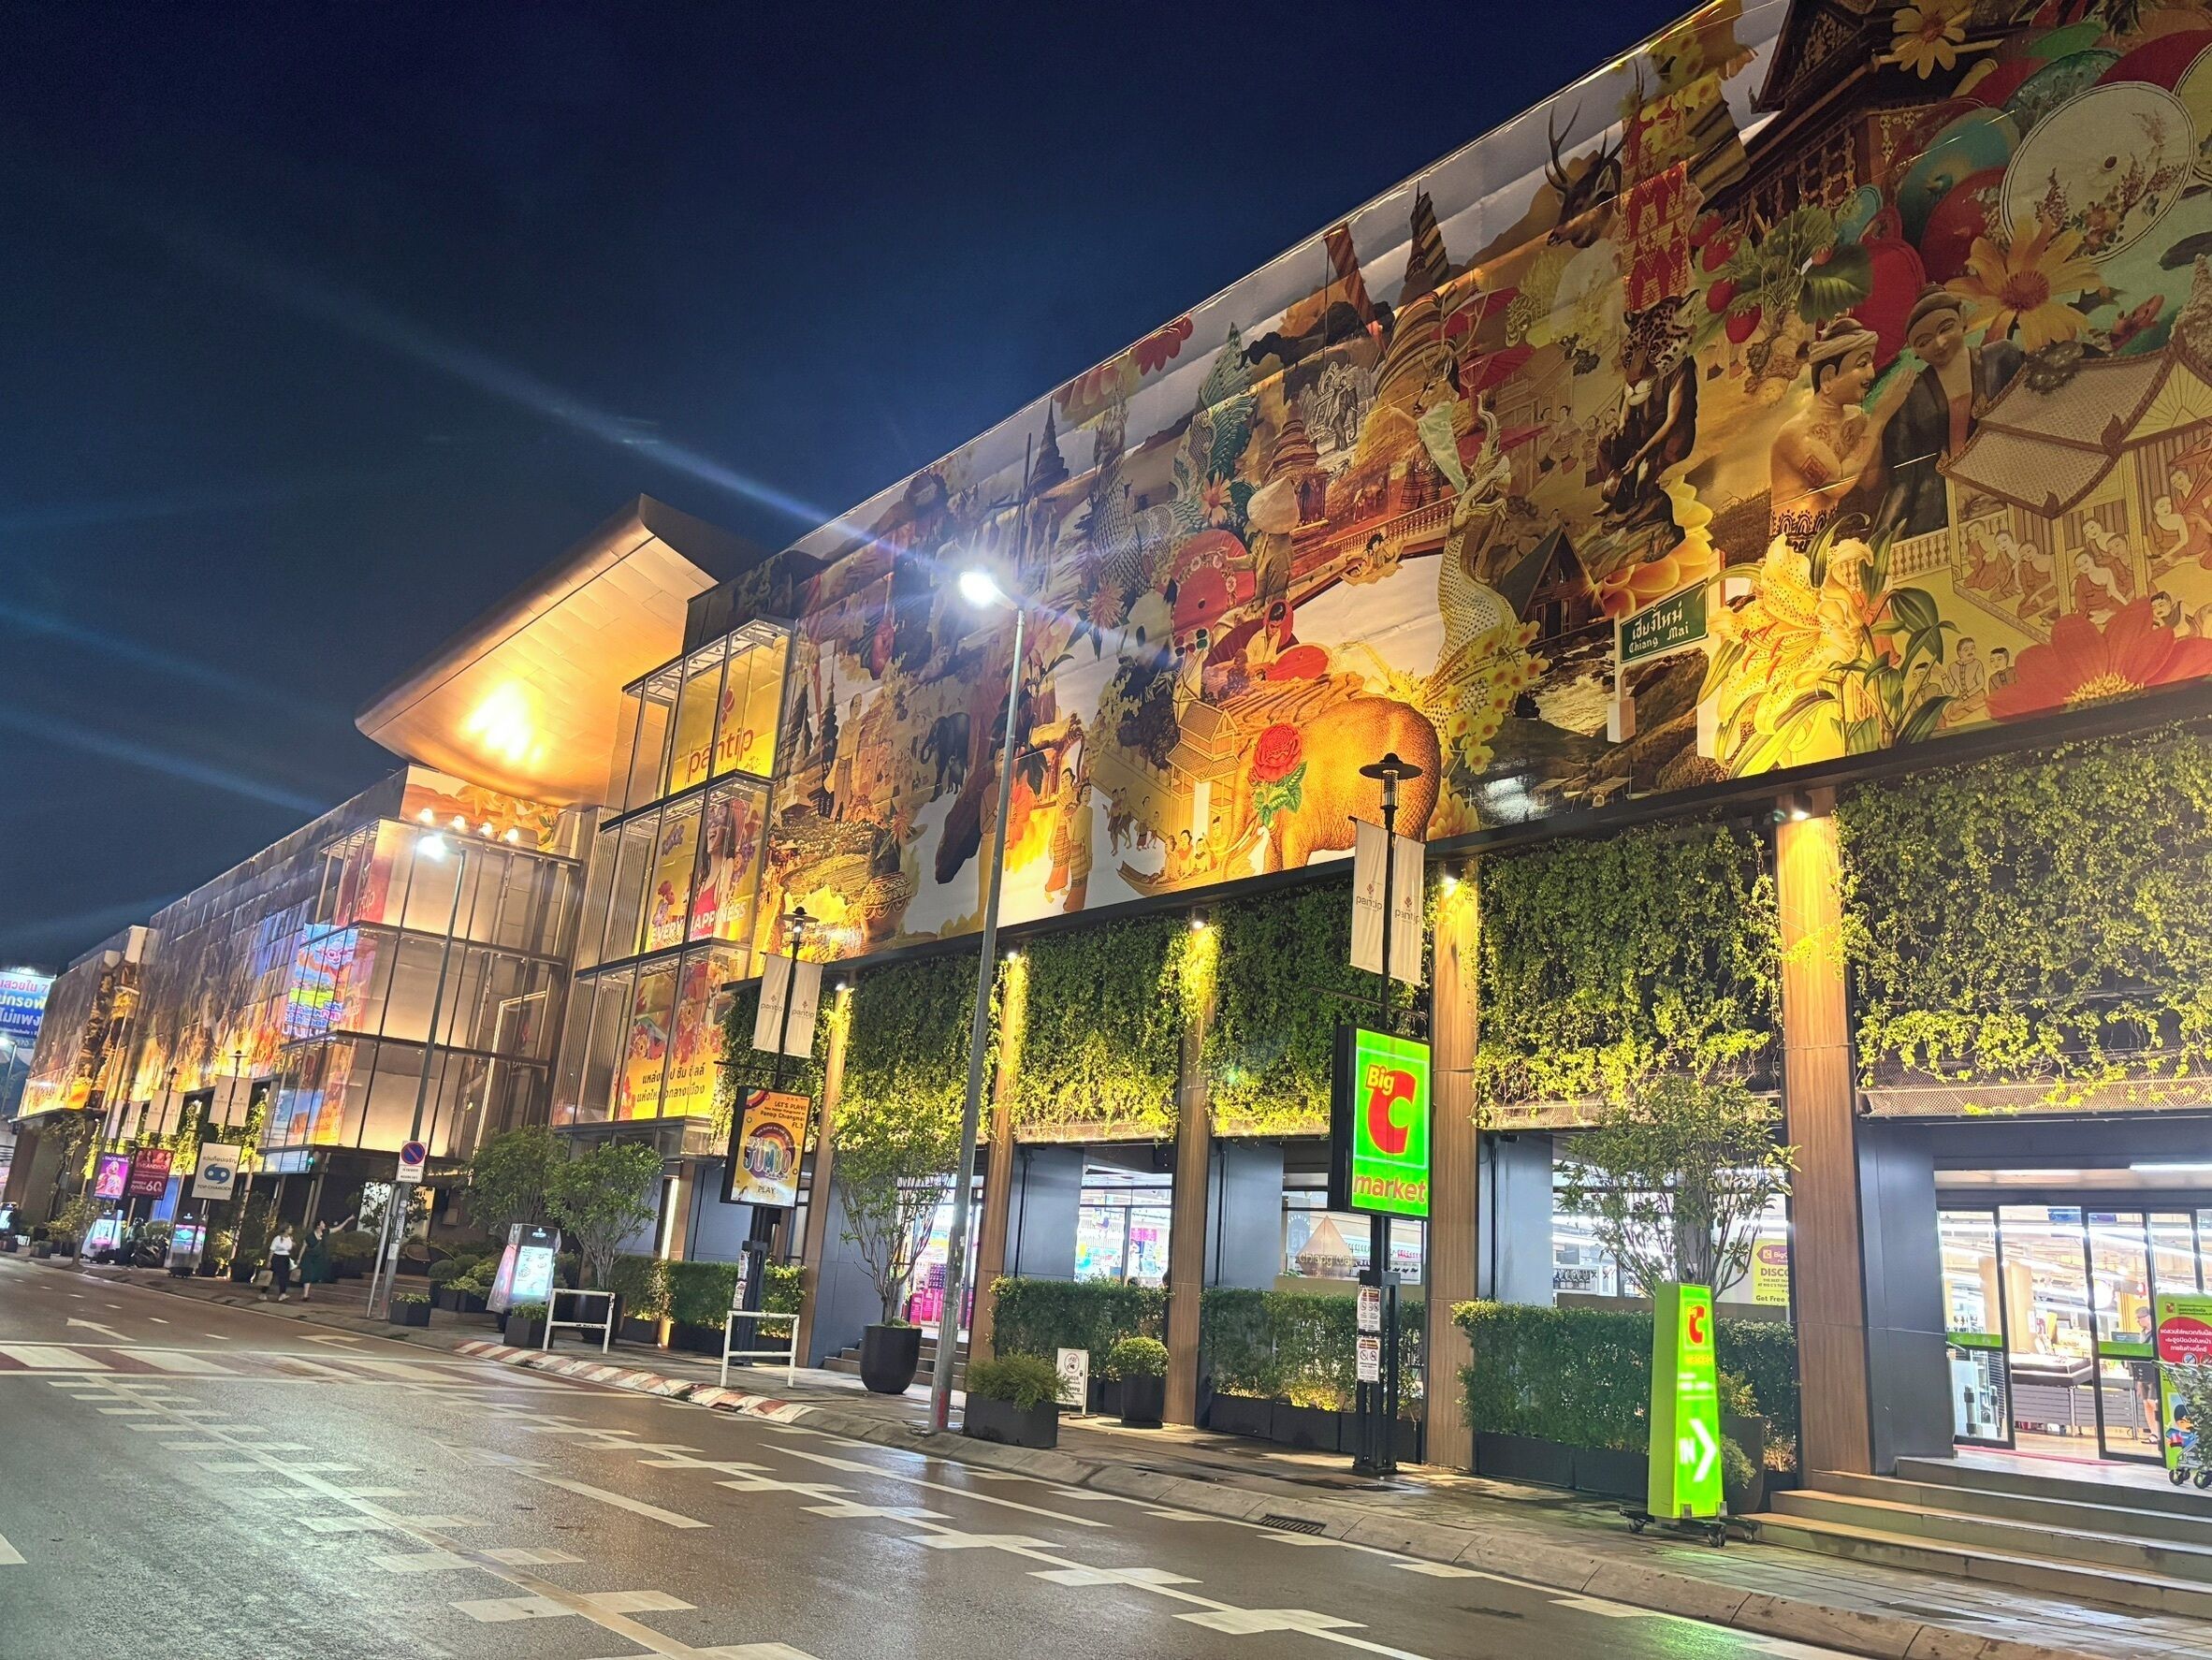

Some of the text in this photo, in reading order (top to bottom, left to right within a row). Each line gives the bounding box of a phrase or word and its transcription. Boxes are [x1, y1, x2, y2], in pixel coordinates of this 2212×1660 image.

[1628, 621, 1689, 653] Chiang Mai
[688, 728, 754, 782] pantip
[1356, 896, 1383, 911] pantip
[1394, 909, 1421, 925] pantip
[1365, 1064, 1418, 1154] Big C
[743, 1146, 792, 1174] JUMBO
[1353, 1174, 1426, 1202] market
[1298, 1250, 1333, 1268] Chiang
[1679, 1437, 1695, 1464] IN
